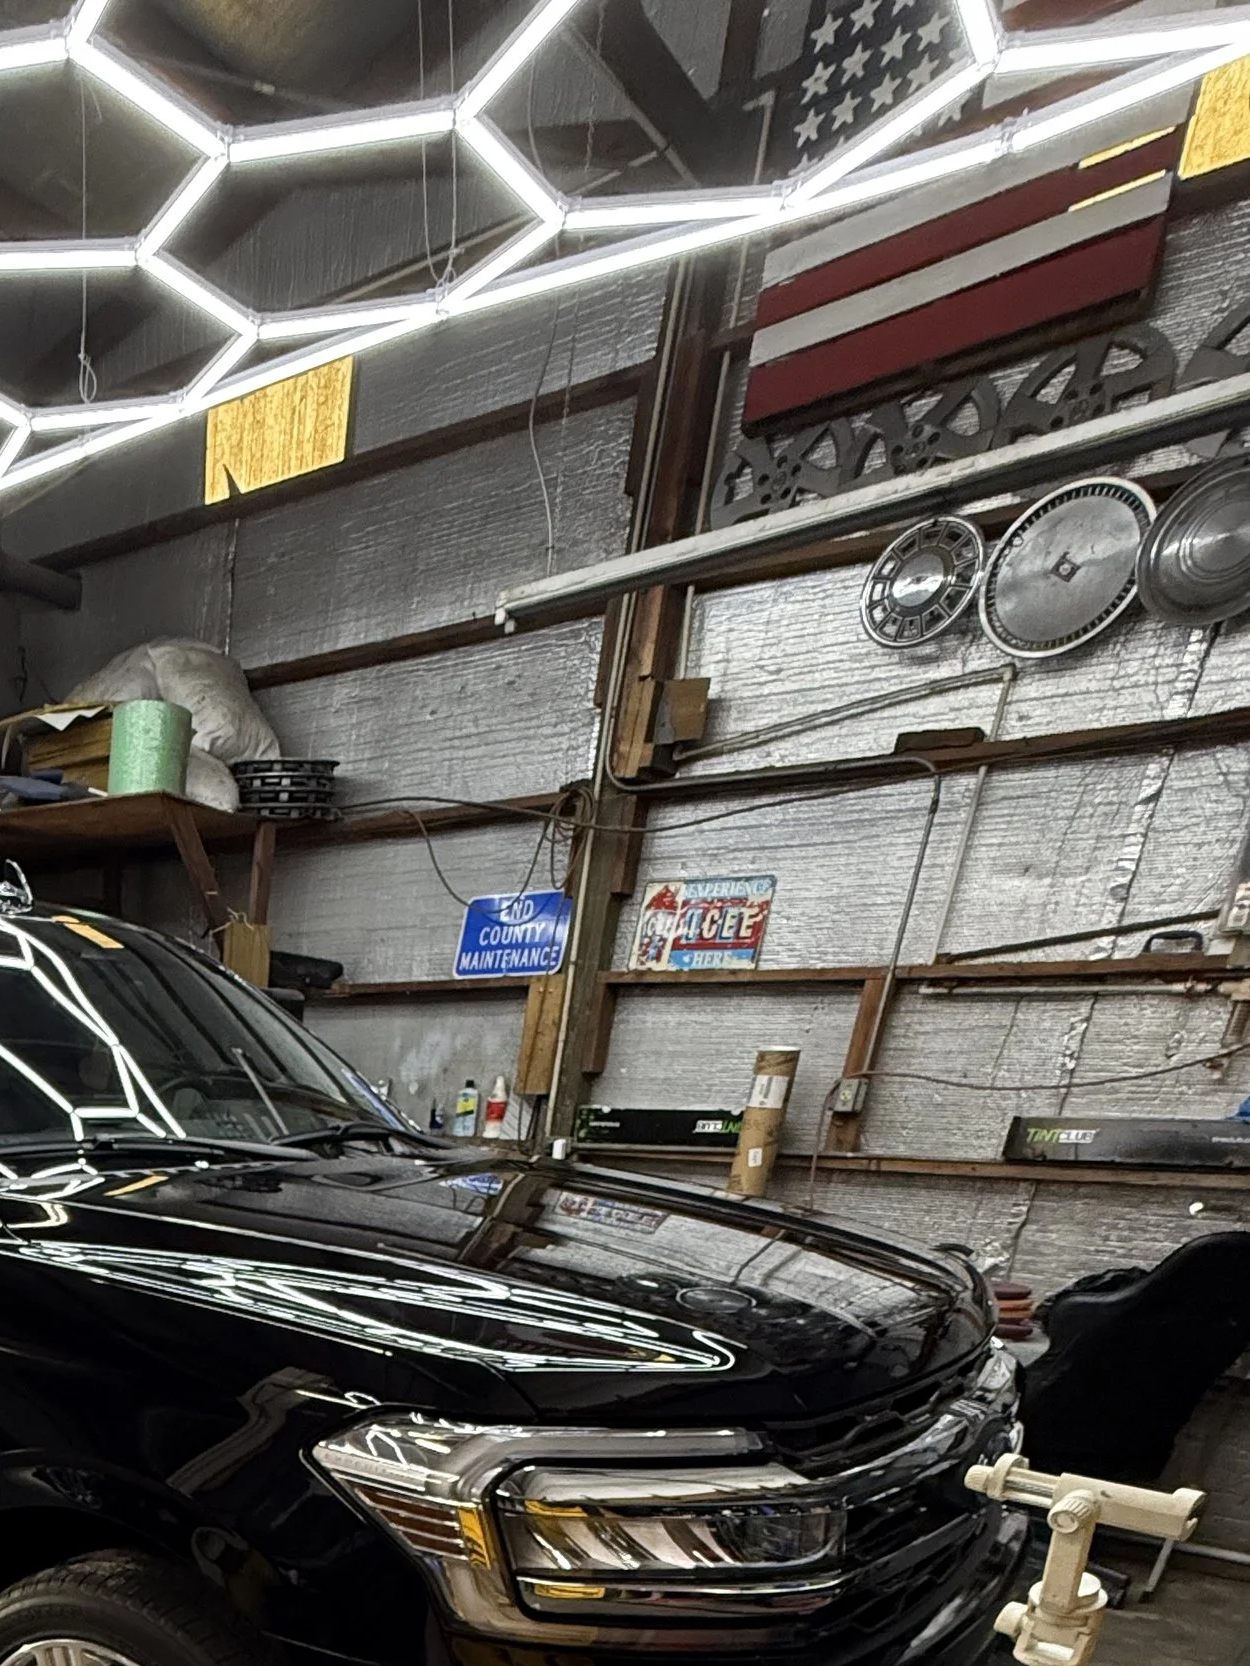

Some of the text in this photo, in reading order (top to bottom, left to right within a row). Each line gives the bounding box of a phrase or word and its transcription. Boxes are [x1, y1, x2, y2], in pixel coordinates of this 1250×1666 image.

[684, 878, 772, 898] EXPERIENCE
[499, 899, 534, 921] END
[478, 922, 546, 946] COUNTY
[683, 907, 760, 942] ICEE
[458, 946, 560, 971] MAINTENANCE
[693, 951, 734, 967] HERE
